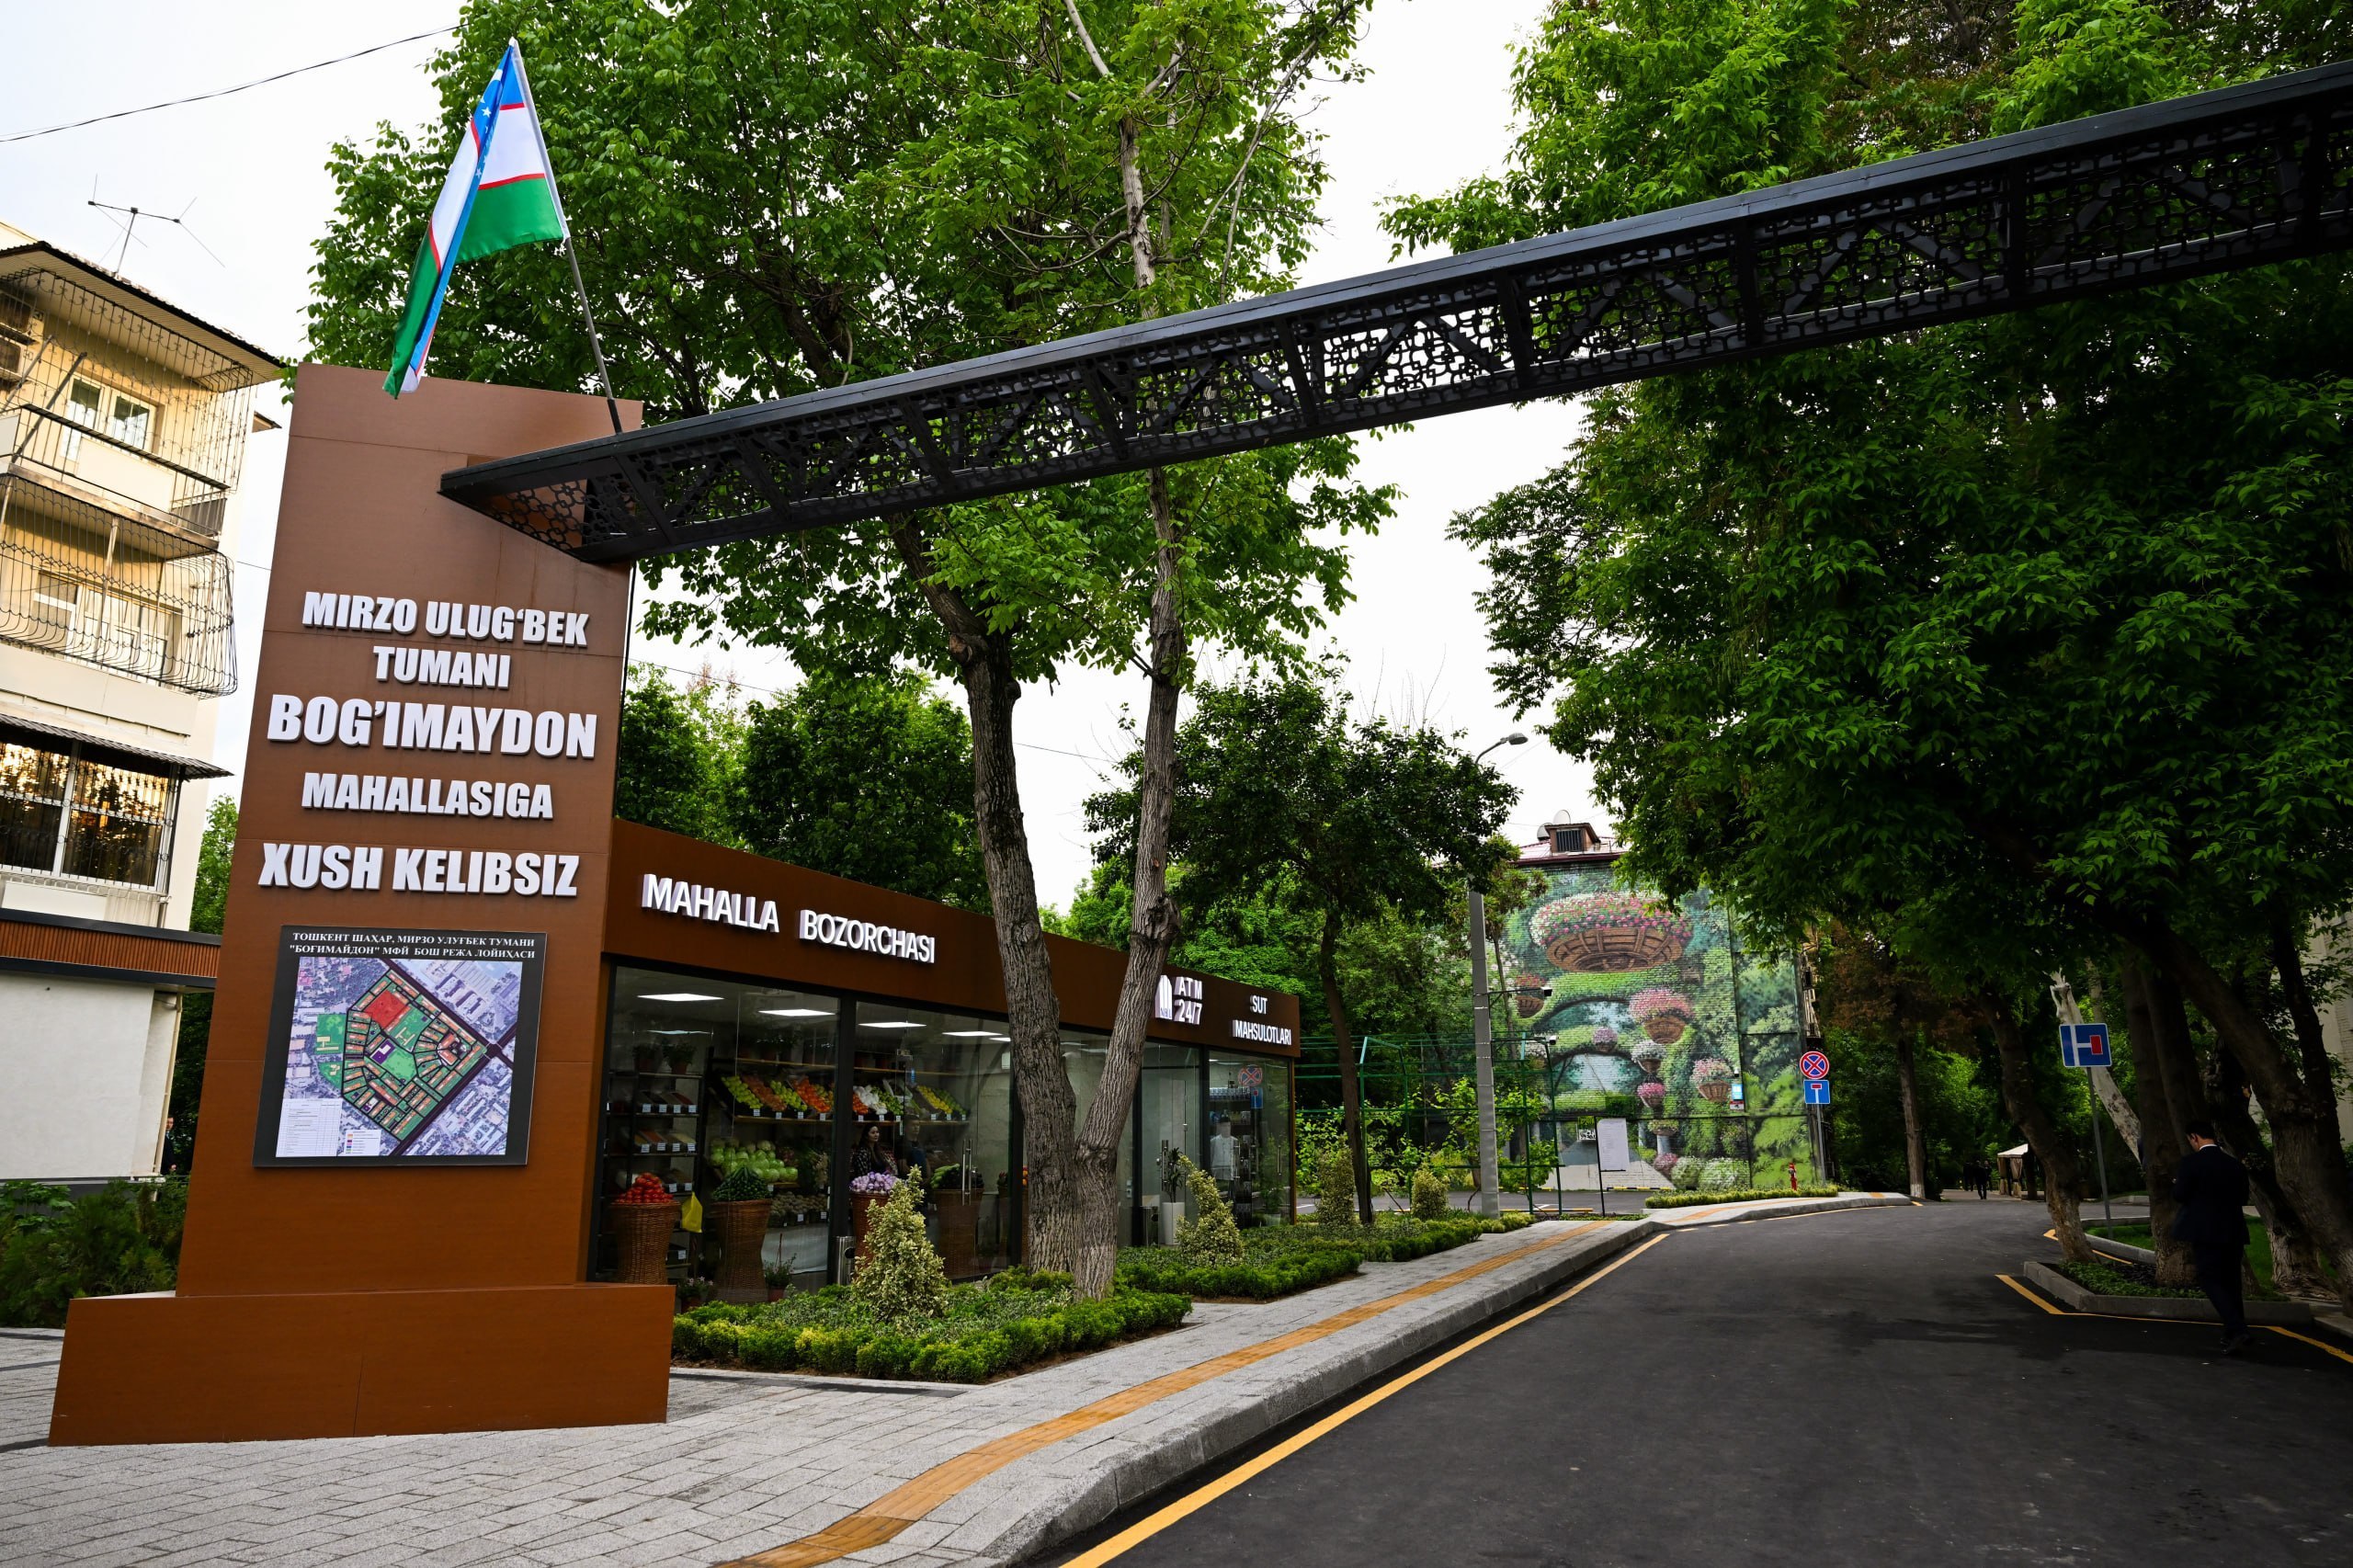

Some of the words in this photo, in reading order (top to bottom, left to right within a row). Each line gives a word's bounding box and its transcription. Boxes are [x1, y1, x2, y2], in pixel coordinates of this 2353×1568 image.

[301, 591, 417, 634] MIRZO
[372, 645, 511, 689] TUMANI
[301, 772, 553, 819] MAHALLASIGA
[257, 843, 384, 891] XUSH
[392, 847, 580, 897] KELIBSIZ
[642, 873, 779, 933] MAHALLA
[799, 909, 935, 963] BOZORCHASI
[292, 932, 350, 942] ТОШКЕНТ
[397, 935, 435, 944] МИРЗО
[437, 936, 487, 946] УЛУҒБЕК
[489, 937, 535, 947] ТУМАНИ
[382, 945, 409, 956] МФЙ
[414, 948, 440, 957] БОШ
[442, 948, 472, 957] РЕЖА
[474, 947, 535, 960] ЛОЙИҲАСИ
[1175, 976, 1202, 1000] ATM
[1175, 999, 1203, 1025] 24/7
[1250, 994, 1268, 1015] SUT
[1233, 1019, 1292, 1045] MAHSULOTLARI
